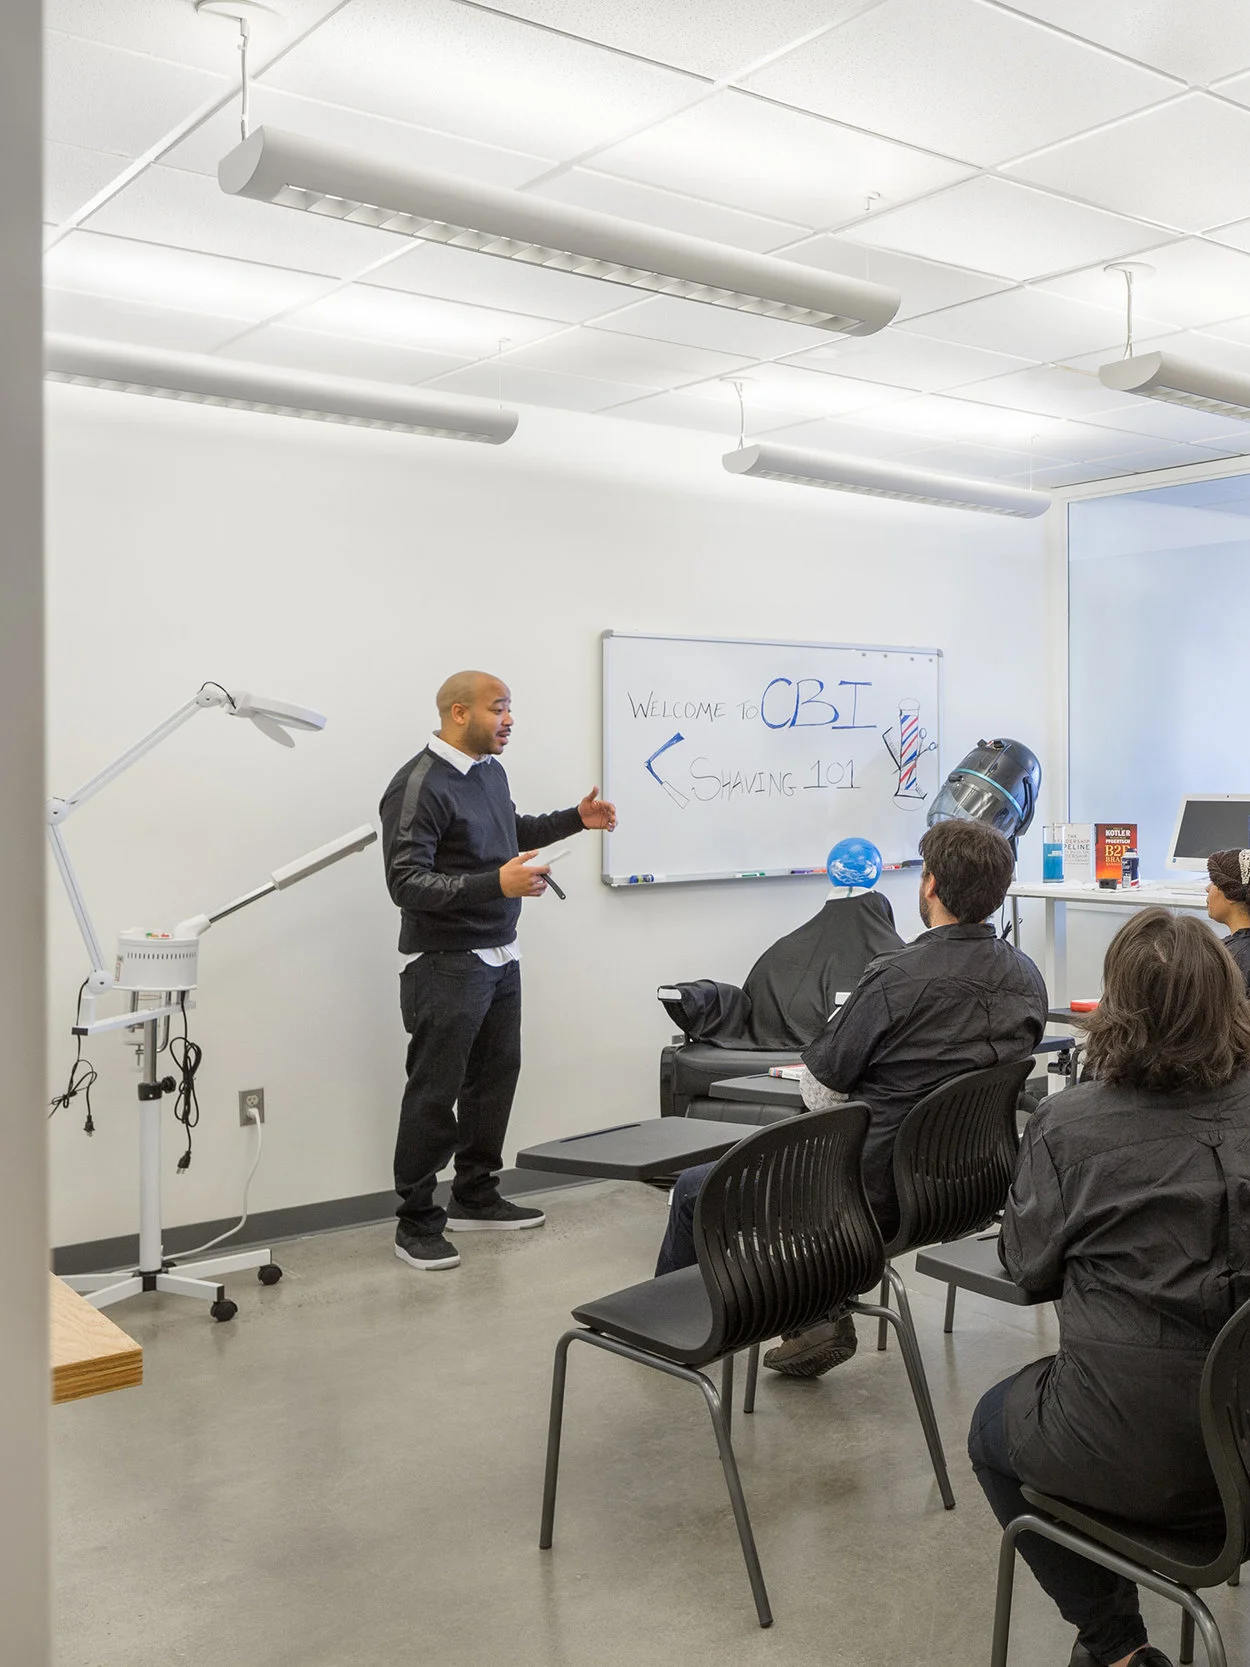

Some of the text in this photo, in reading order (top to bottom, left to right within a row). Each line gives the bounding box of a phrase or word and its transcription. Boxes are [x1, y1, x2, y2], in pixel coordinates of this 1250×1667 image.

[760, 677, 877, 729] CBI
[802, 758, 862, 790] 101
[1105, 829, 1131, 837] KOTLER
